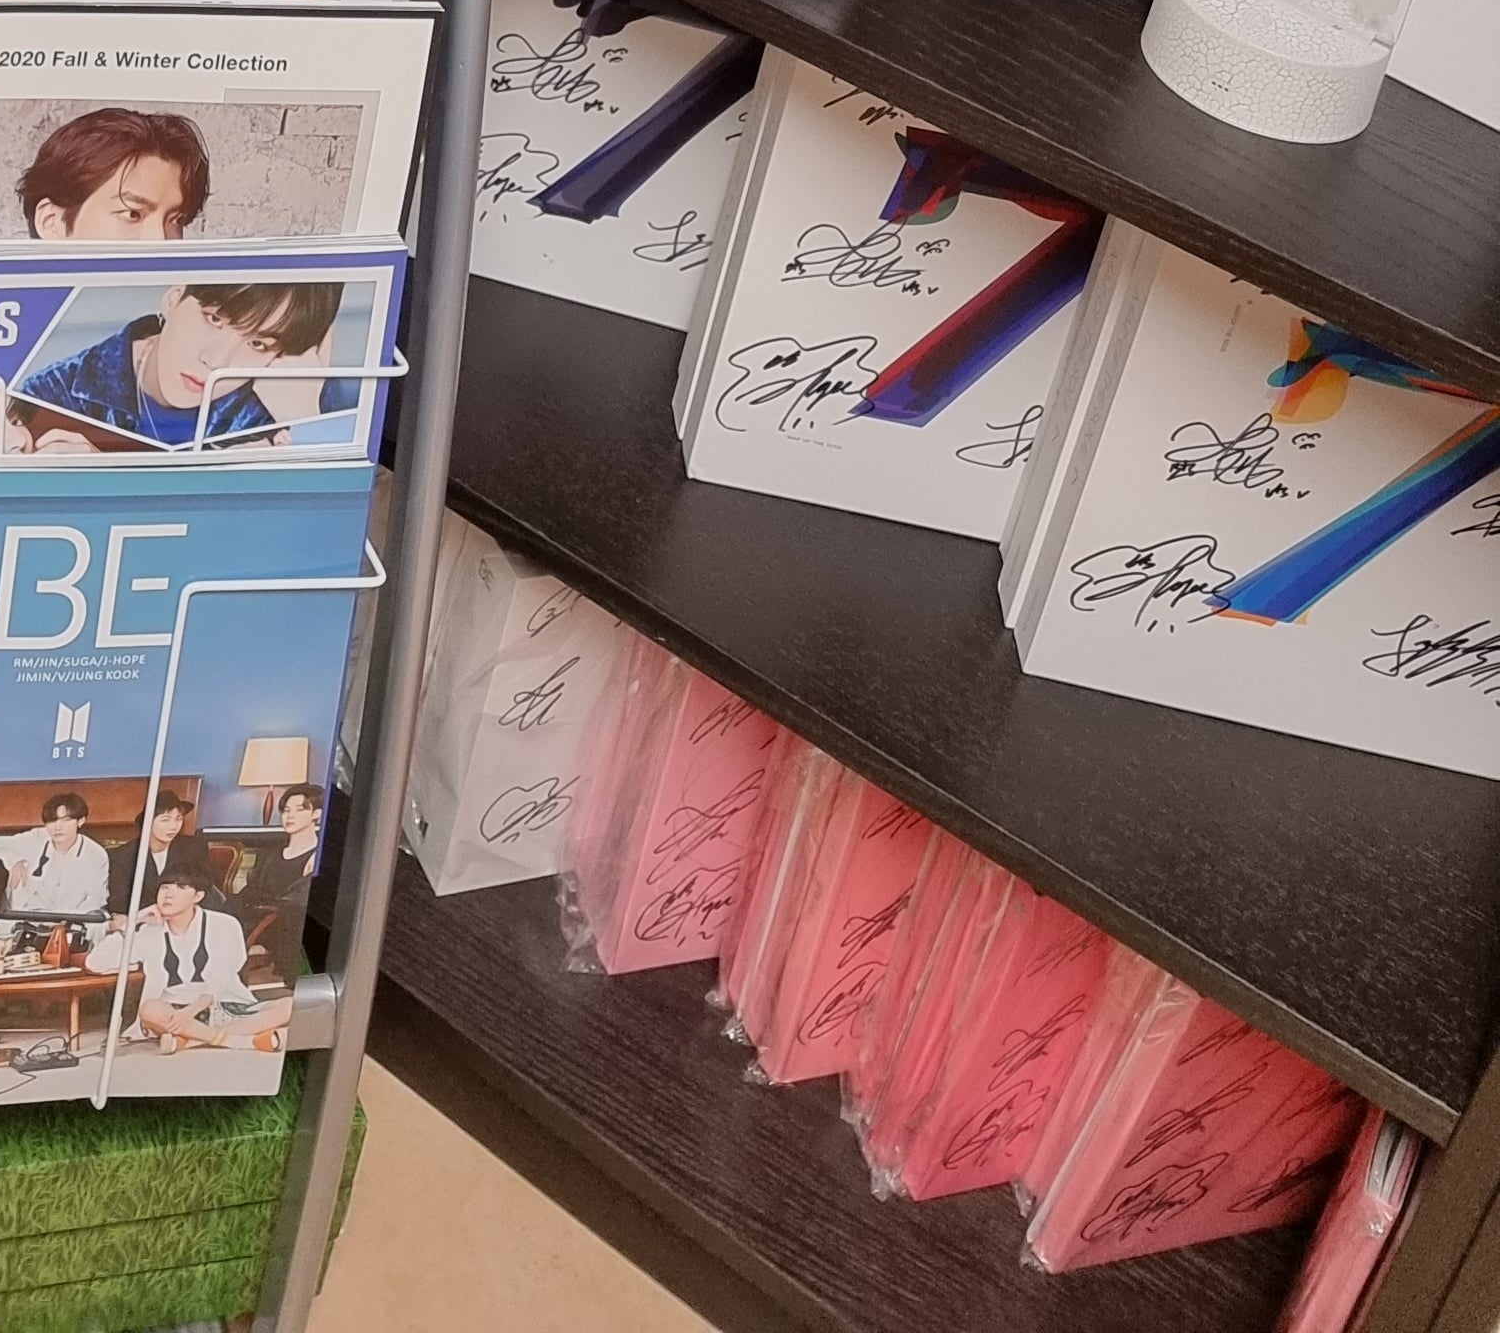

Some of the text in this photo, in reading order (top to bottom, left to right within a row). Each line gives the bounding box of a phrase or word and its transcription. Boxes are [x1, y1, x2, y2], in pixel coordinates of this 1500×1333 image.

[52, 51, 88, 68] Fall
[94, 52, 108, 68] &
[115, 51, 181, 70] Winter
[187, 53, 288, 72] Collection
[13, 654, 147, 669] RM/JIN/SUGA/J-HOPE
[15, 669, 140, 683] JIMIN/V/JUNG KOOK
[52, 747, 86, 759] BTS
